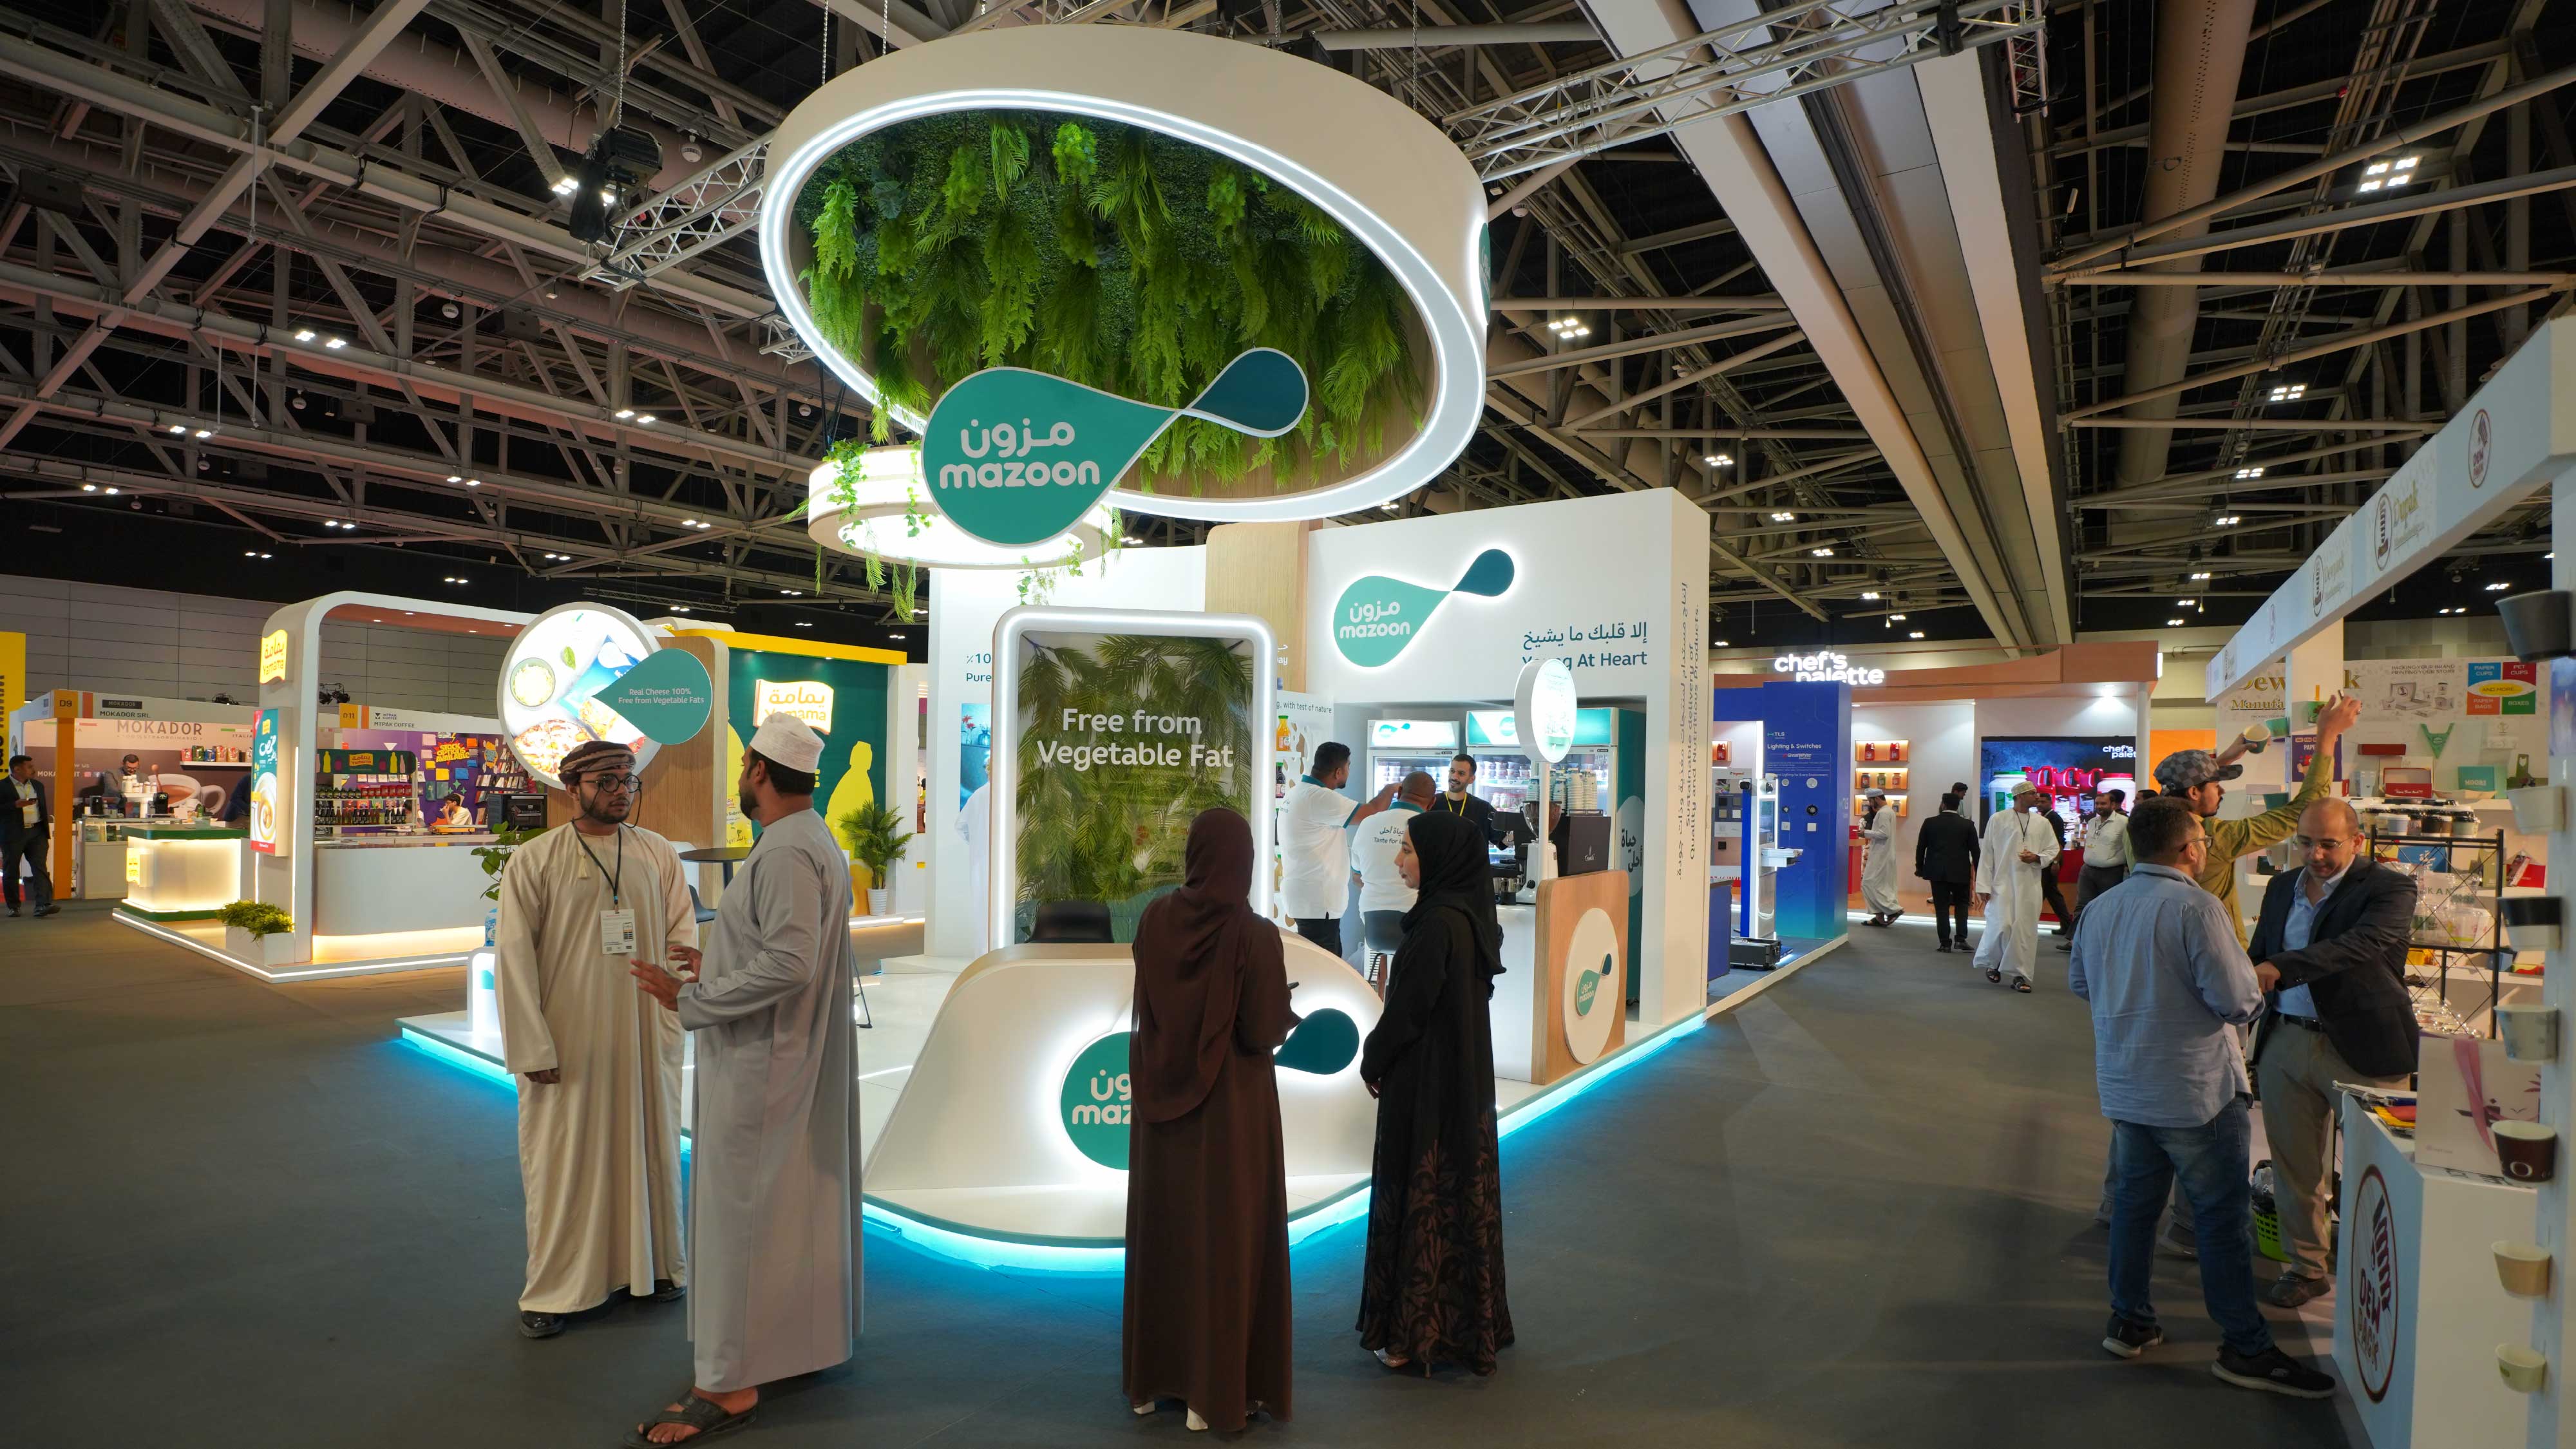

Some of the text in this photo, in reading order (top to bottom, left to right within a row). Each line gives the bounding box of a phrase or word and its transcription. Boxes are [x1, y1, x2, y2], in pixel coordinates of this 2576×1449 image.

[961, 418, 1075, 459] مزون
[939, 460, 1100, 489] mazoon
[1350, 600, 1400, 623] مزون
[1340, 621, 1410, 639] mazoon
[1523, 621, 1647, 650] إلا قلبك ما يشيخ
[264, 635, 285, 659] يمامة
[1689, 643, 1694, 661] of
[263, 659, 284, 676] Yamama
[1577, 654, 1595, 667] At
[1600, 651, 1647, 667] Heart
[1774, 650, 1848, 672] chef's
[966, 673, 992, 681] Pure
[653, 697, 688, 705] Vegetable
[768, 687, 825, 708] يمامة
[764, 708, 827, 721] Ymama
[1283, 701, 1296, 710] with
[1296, 702, 1307, 711] test
[1314, 705, 1332, 714] nature
[117, 720, 202, 735] MOKADOR
[1063, 708, 1202, 735] Free from
[437, 747, 466, 756] OPTIONS
[1037, 740, 1233, 772] Vegetable Fat
[2112, 751, 2136, 759] palet
[1379, 826, 1393, 835] أحلى
[1621, 828, 1636, 853] حياة
[1091, 1069, 1132, 1101] ون
[1072, 1104, 1132, 1124] maz
